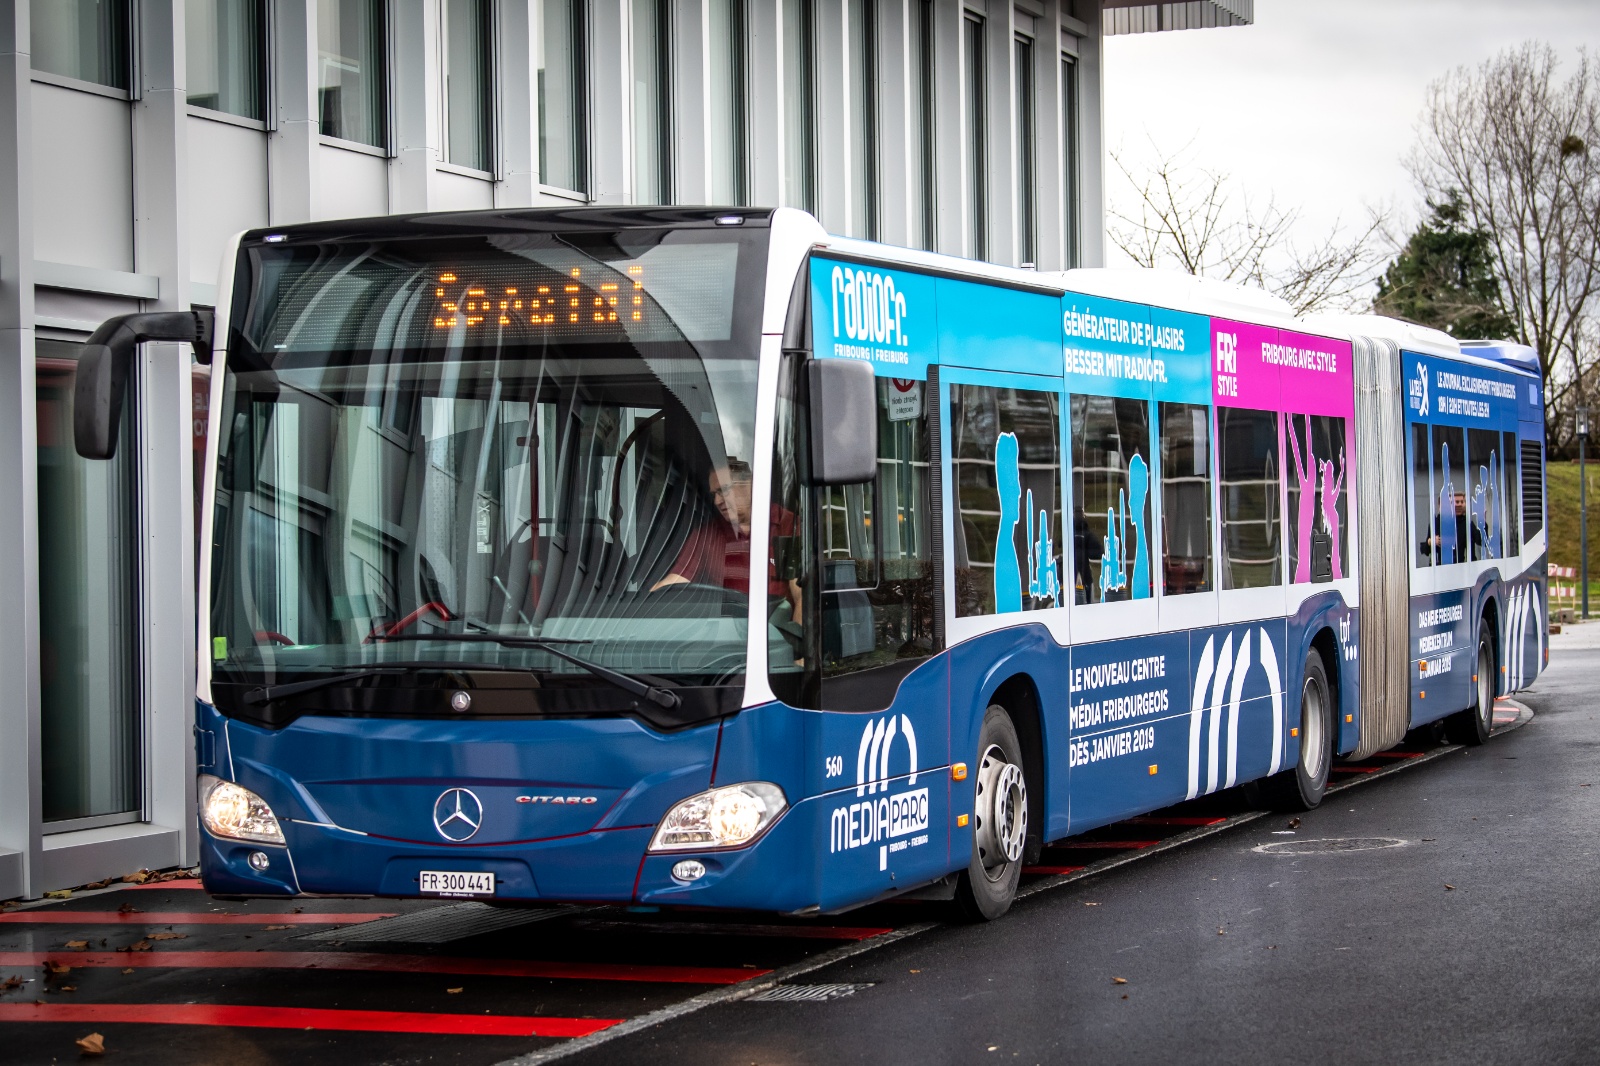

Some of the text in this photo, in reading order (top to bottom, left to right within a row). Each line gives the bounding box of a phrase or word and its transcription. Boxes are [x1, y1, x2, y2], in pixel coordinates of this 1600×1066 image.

[1063, 304, 1185, 352] GÉNÉRATEUR DE PLAISIRS
[833, 343, 870, 360] FRIBOURG
[875, 348, 909, 365] FREIBURG
[1065, 347, 1168, 384] BESSER MIT RADIOFR.
[1261, 342, 1337, 373] FRIBOURG AVEC STYLE
[1217, 374, 1238, 397] STYLE
[1436, 370, 1442, 388] LE
[1418, 611, 1427, 629] DAS
[1427, 609, 1438, 626] NEUE
[1070, 655, 1166, 693] LE NOUVEAU CENTRE
[1070, 688, 1169, 730] MÉDIA FRIBOURGEOIS
[1070, 726, 1155, 768] DÈS JANVIER 2019
[825, 755, 843, 779] 560
[515, 795, 598, 805] CITARO
